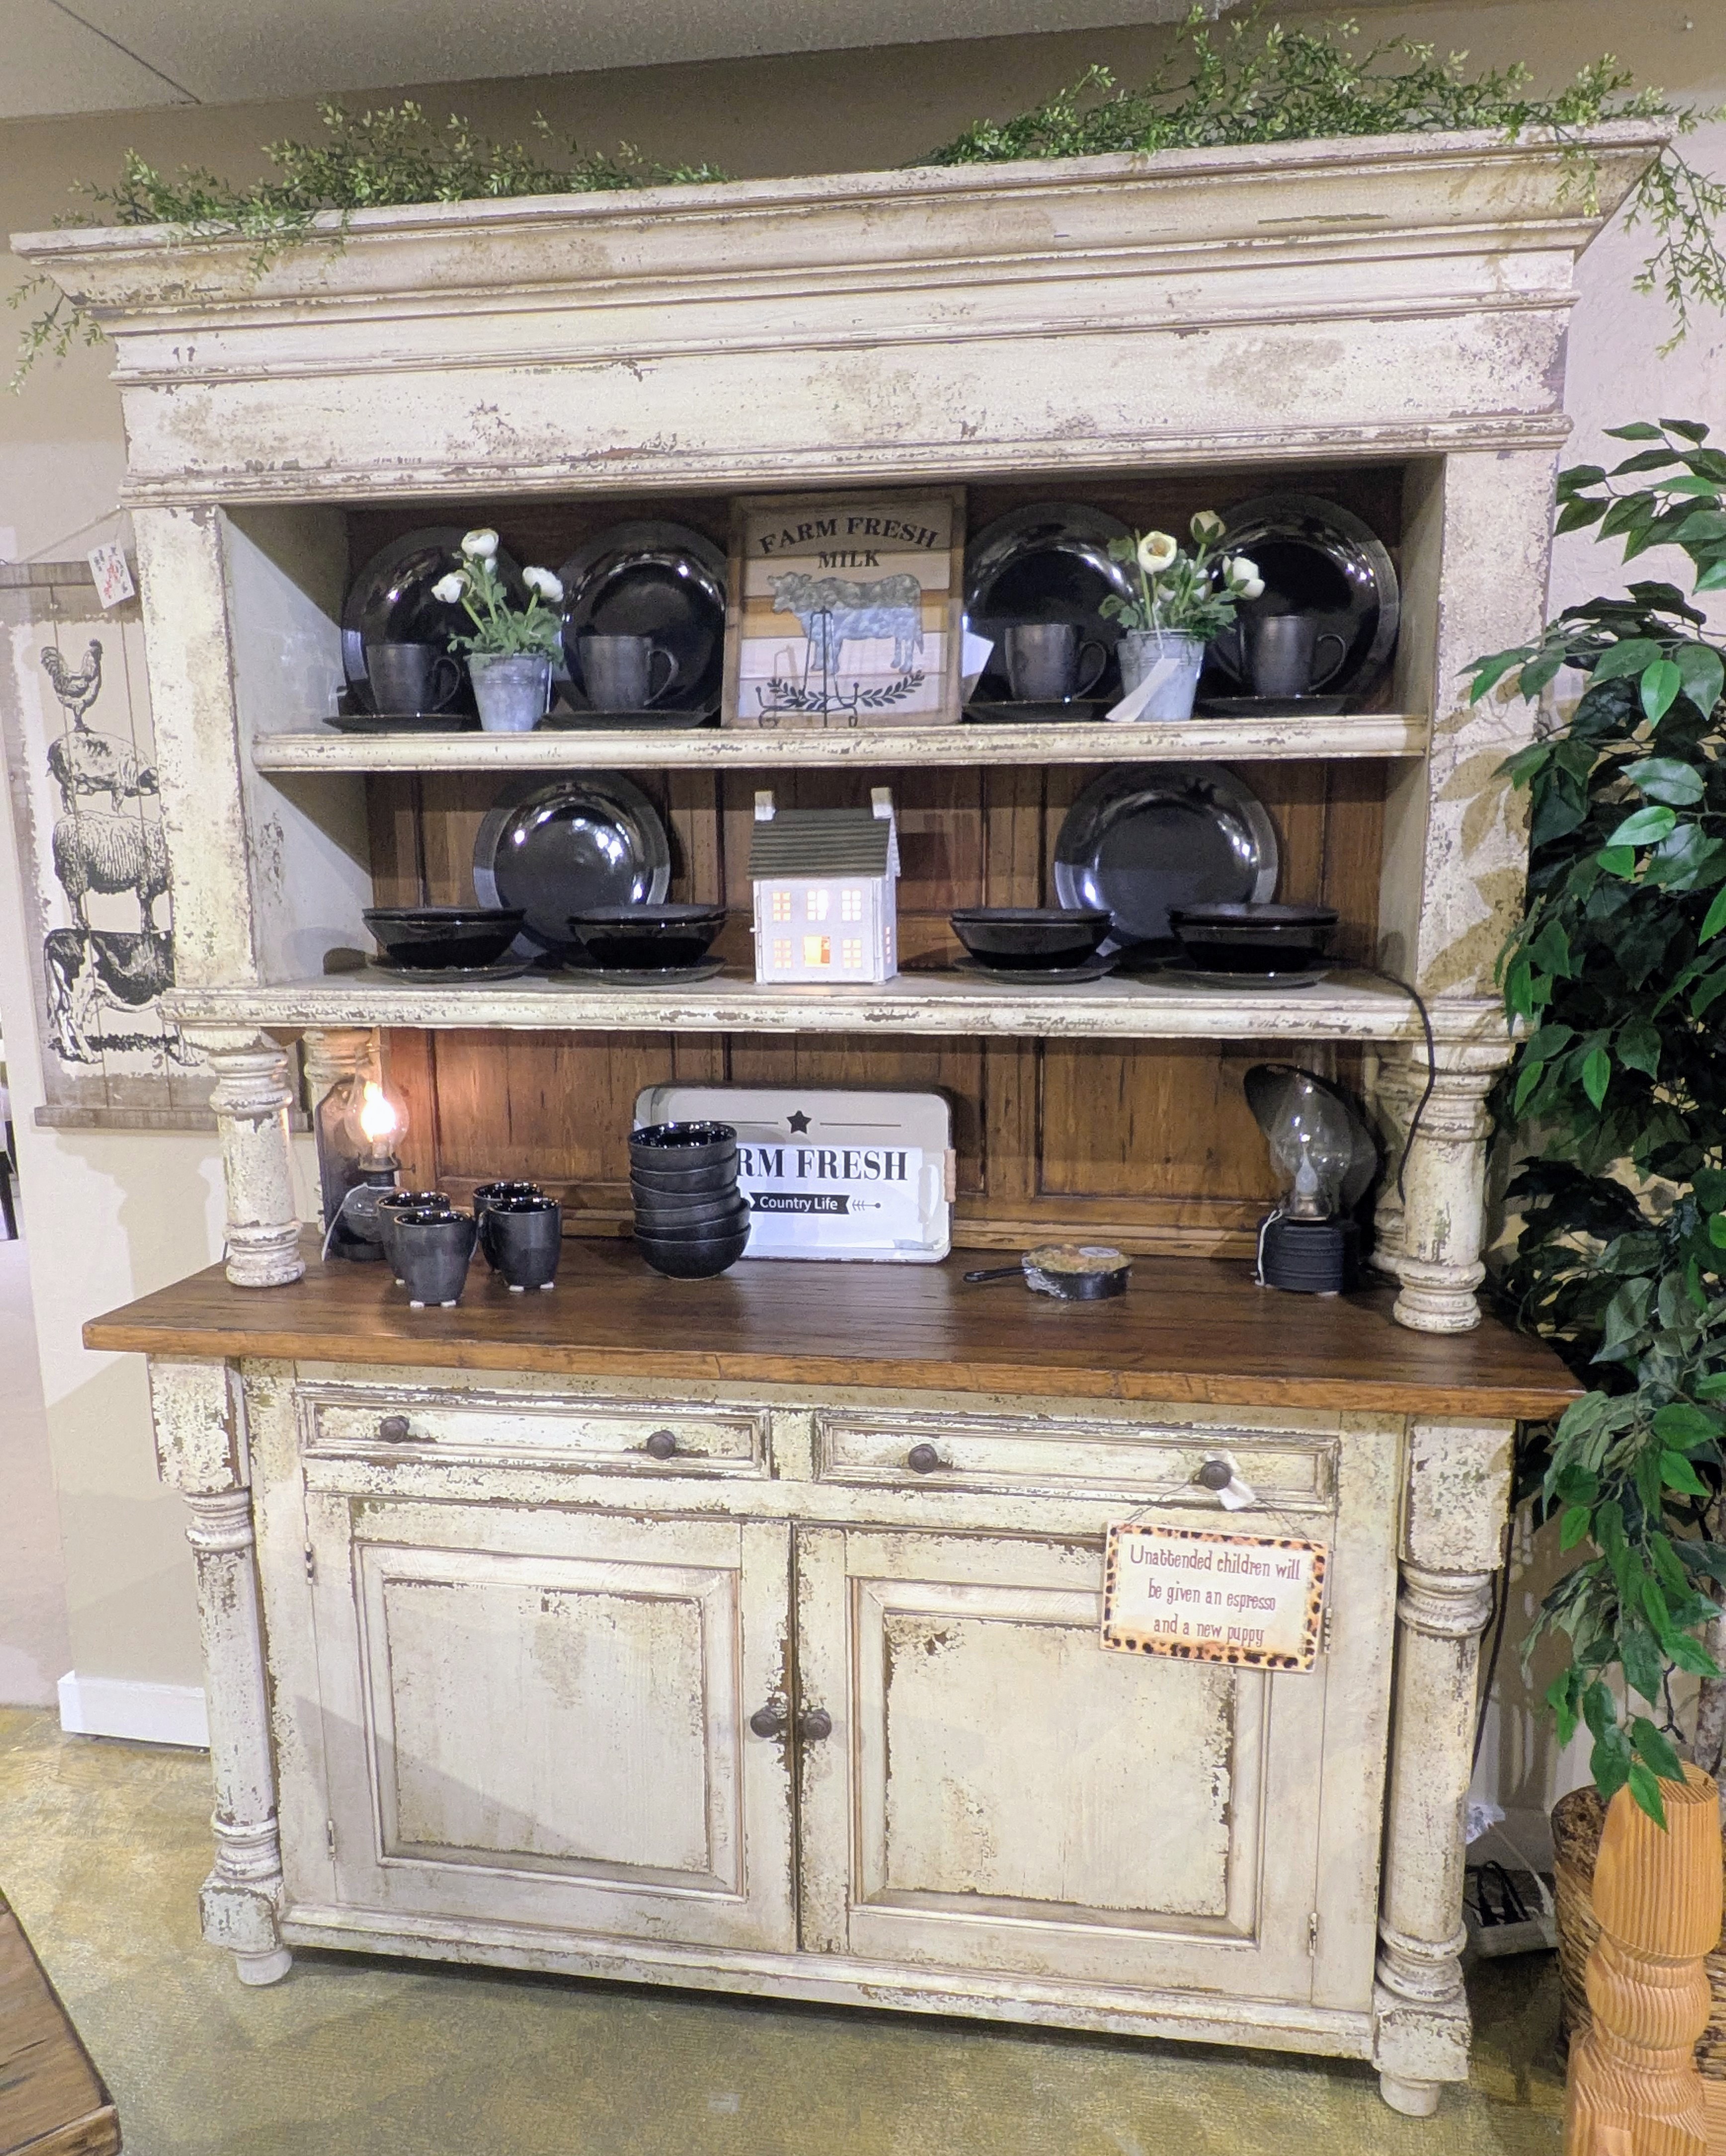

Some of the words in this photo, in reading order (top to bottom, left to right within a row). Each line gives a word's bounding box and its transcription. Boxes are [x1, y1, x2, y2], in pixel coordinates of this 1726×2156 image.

[759, 518, 837, 554] FARM
[847, 517, 939, 548] FRESH
[818, 549, 879, 568] MILK
[736, 1148, 785, 1177] RM
[796, 1149, 908, 1181] FRESH
[760, 1196, 812, 1212] Country
[814, 1197, 838, 1211] Life
[1130, 1544, 1212, 1570] Unattended
[1217, 1552, 1271, 1577] children
[1276, 1559, 1300, 1580] will
[1148, 1578, 1162, 1599] be
[1167, 1581, 1201, 1604] given
[1205, 1590, 1222, 1605] an
[1226, 1592, 1276, 1613] espresso
[1153, 1614, 1178, 1634] and
[1183, 1620, 1190, 1636] a
[1197, 1623, 1222, 1638] new
[1227, 1627, 1265, 1648] puppy
